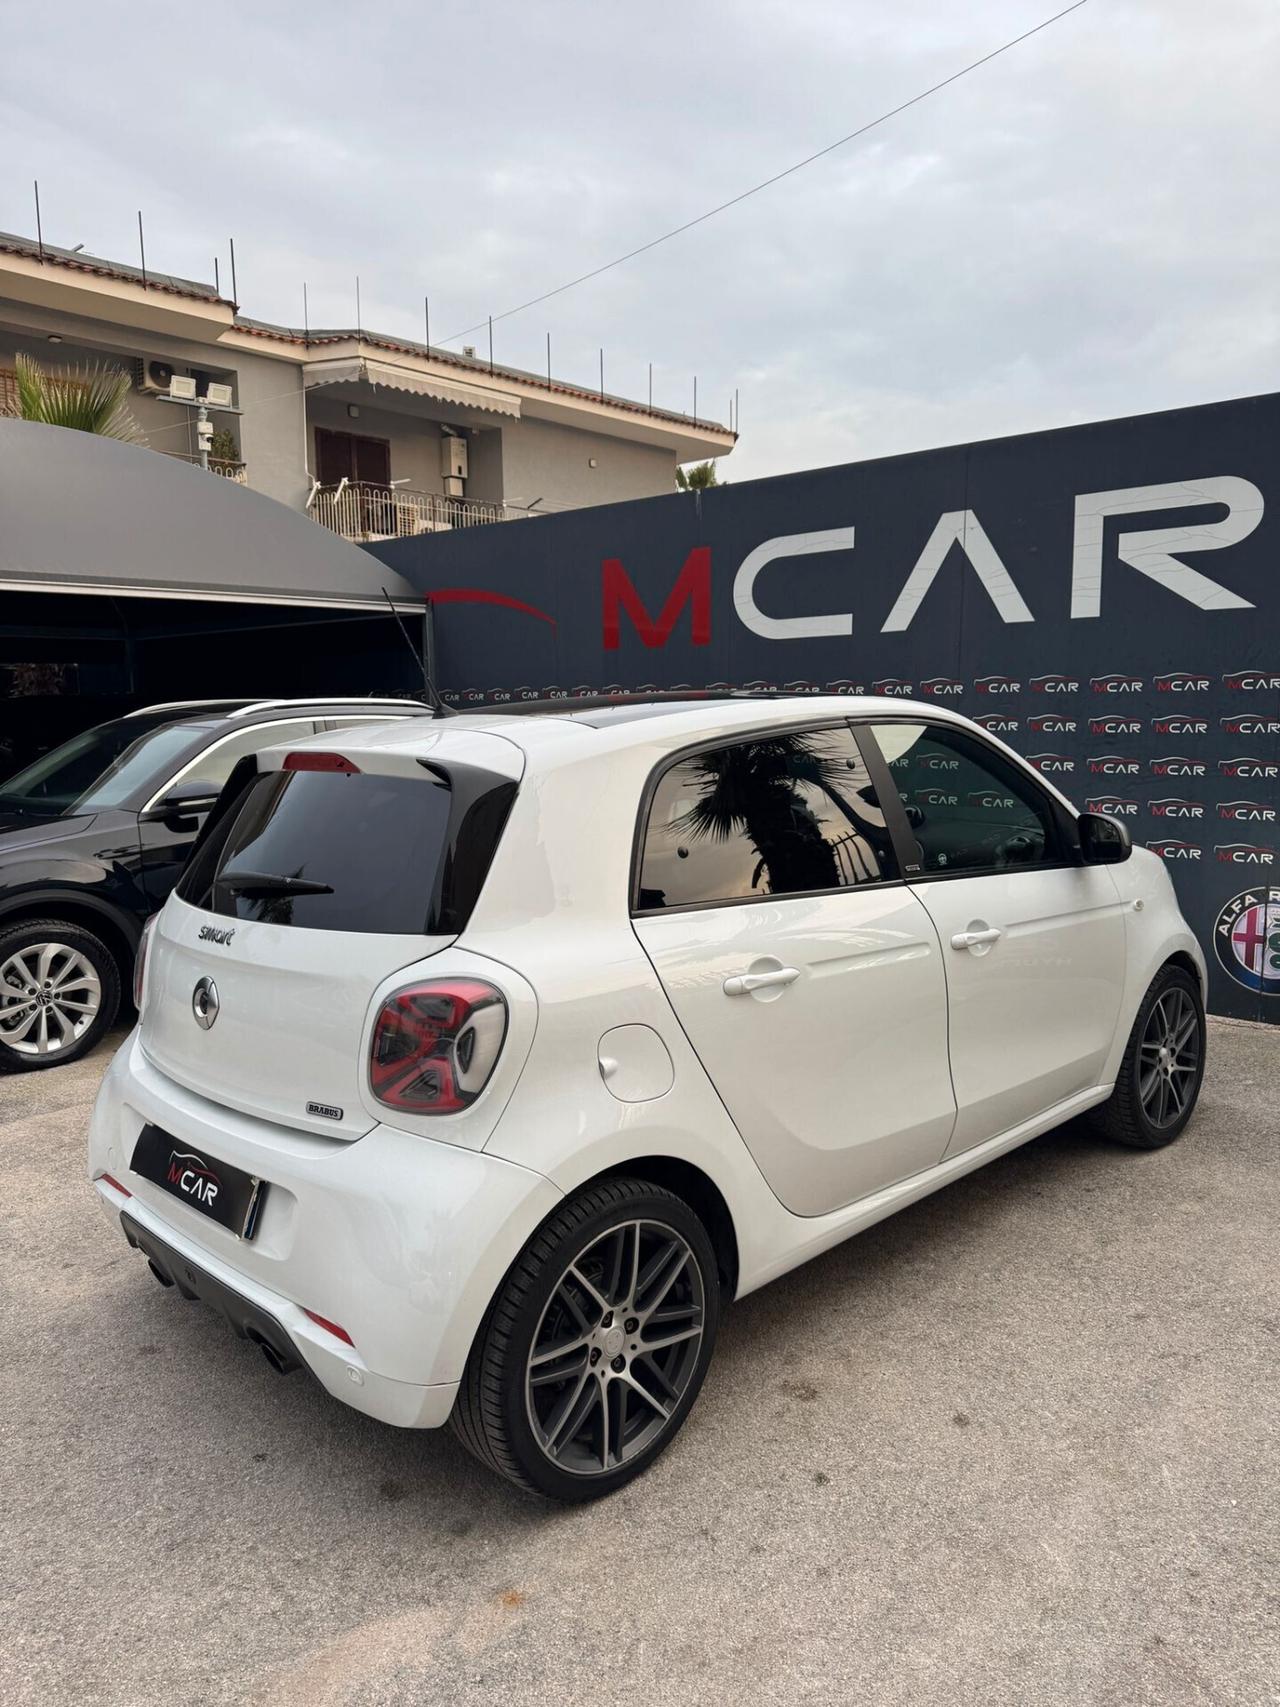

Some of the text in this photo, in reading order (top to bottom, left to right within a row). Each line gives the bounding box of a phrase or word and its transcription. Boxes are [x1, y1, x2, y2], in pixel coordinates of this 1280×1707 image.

[603, 475, 1265, 650] MCAR
[1094, 682, 1143, 693] MCAR
[1157, 680, 1210, 691] MCAR
[1228, 679, 1280, 690] MCAR
[1092, 722, 1141, 733] MCAR
[1155, 722, 1208, 733] MCAR
[1226, 722, 1280, 733] MCAR
[1091, 763, 1140, 774] MCAR
[1153, 764, 1206, 776] MCAR
[1223, 766, 1278, 777] MCAR
[1089, 803, 1138, 815] MCAR
[1151, 806, 1204, 818] MCAR
[1220, 808, 1276, 821] MCAR
[1218, 852, 1274, 865] MCAR
[1218, 893, 1258, 937] ALFA
[198, 925, 235, 946] smart
[308, 1104, 339, 1117] BRABUS
[168, 1161, 218, 1207] MCAR
